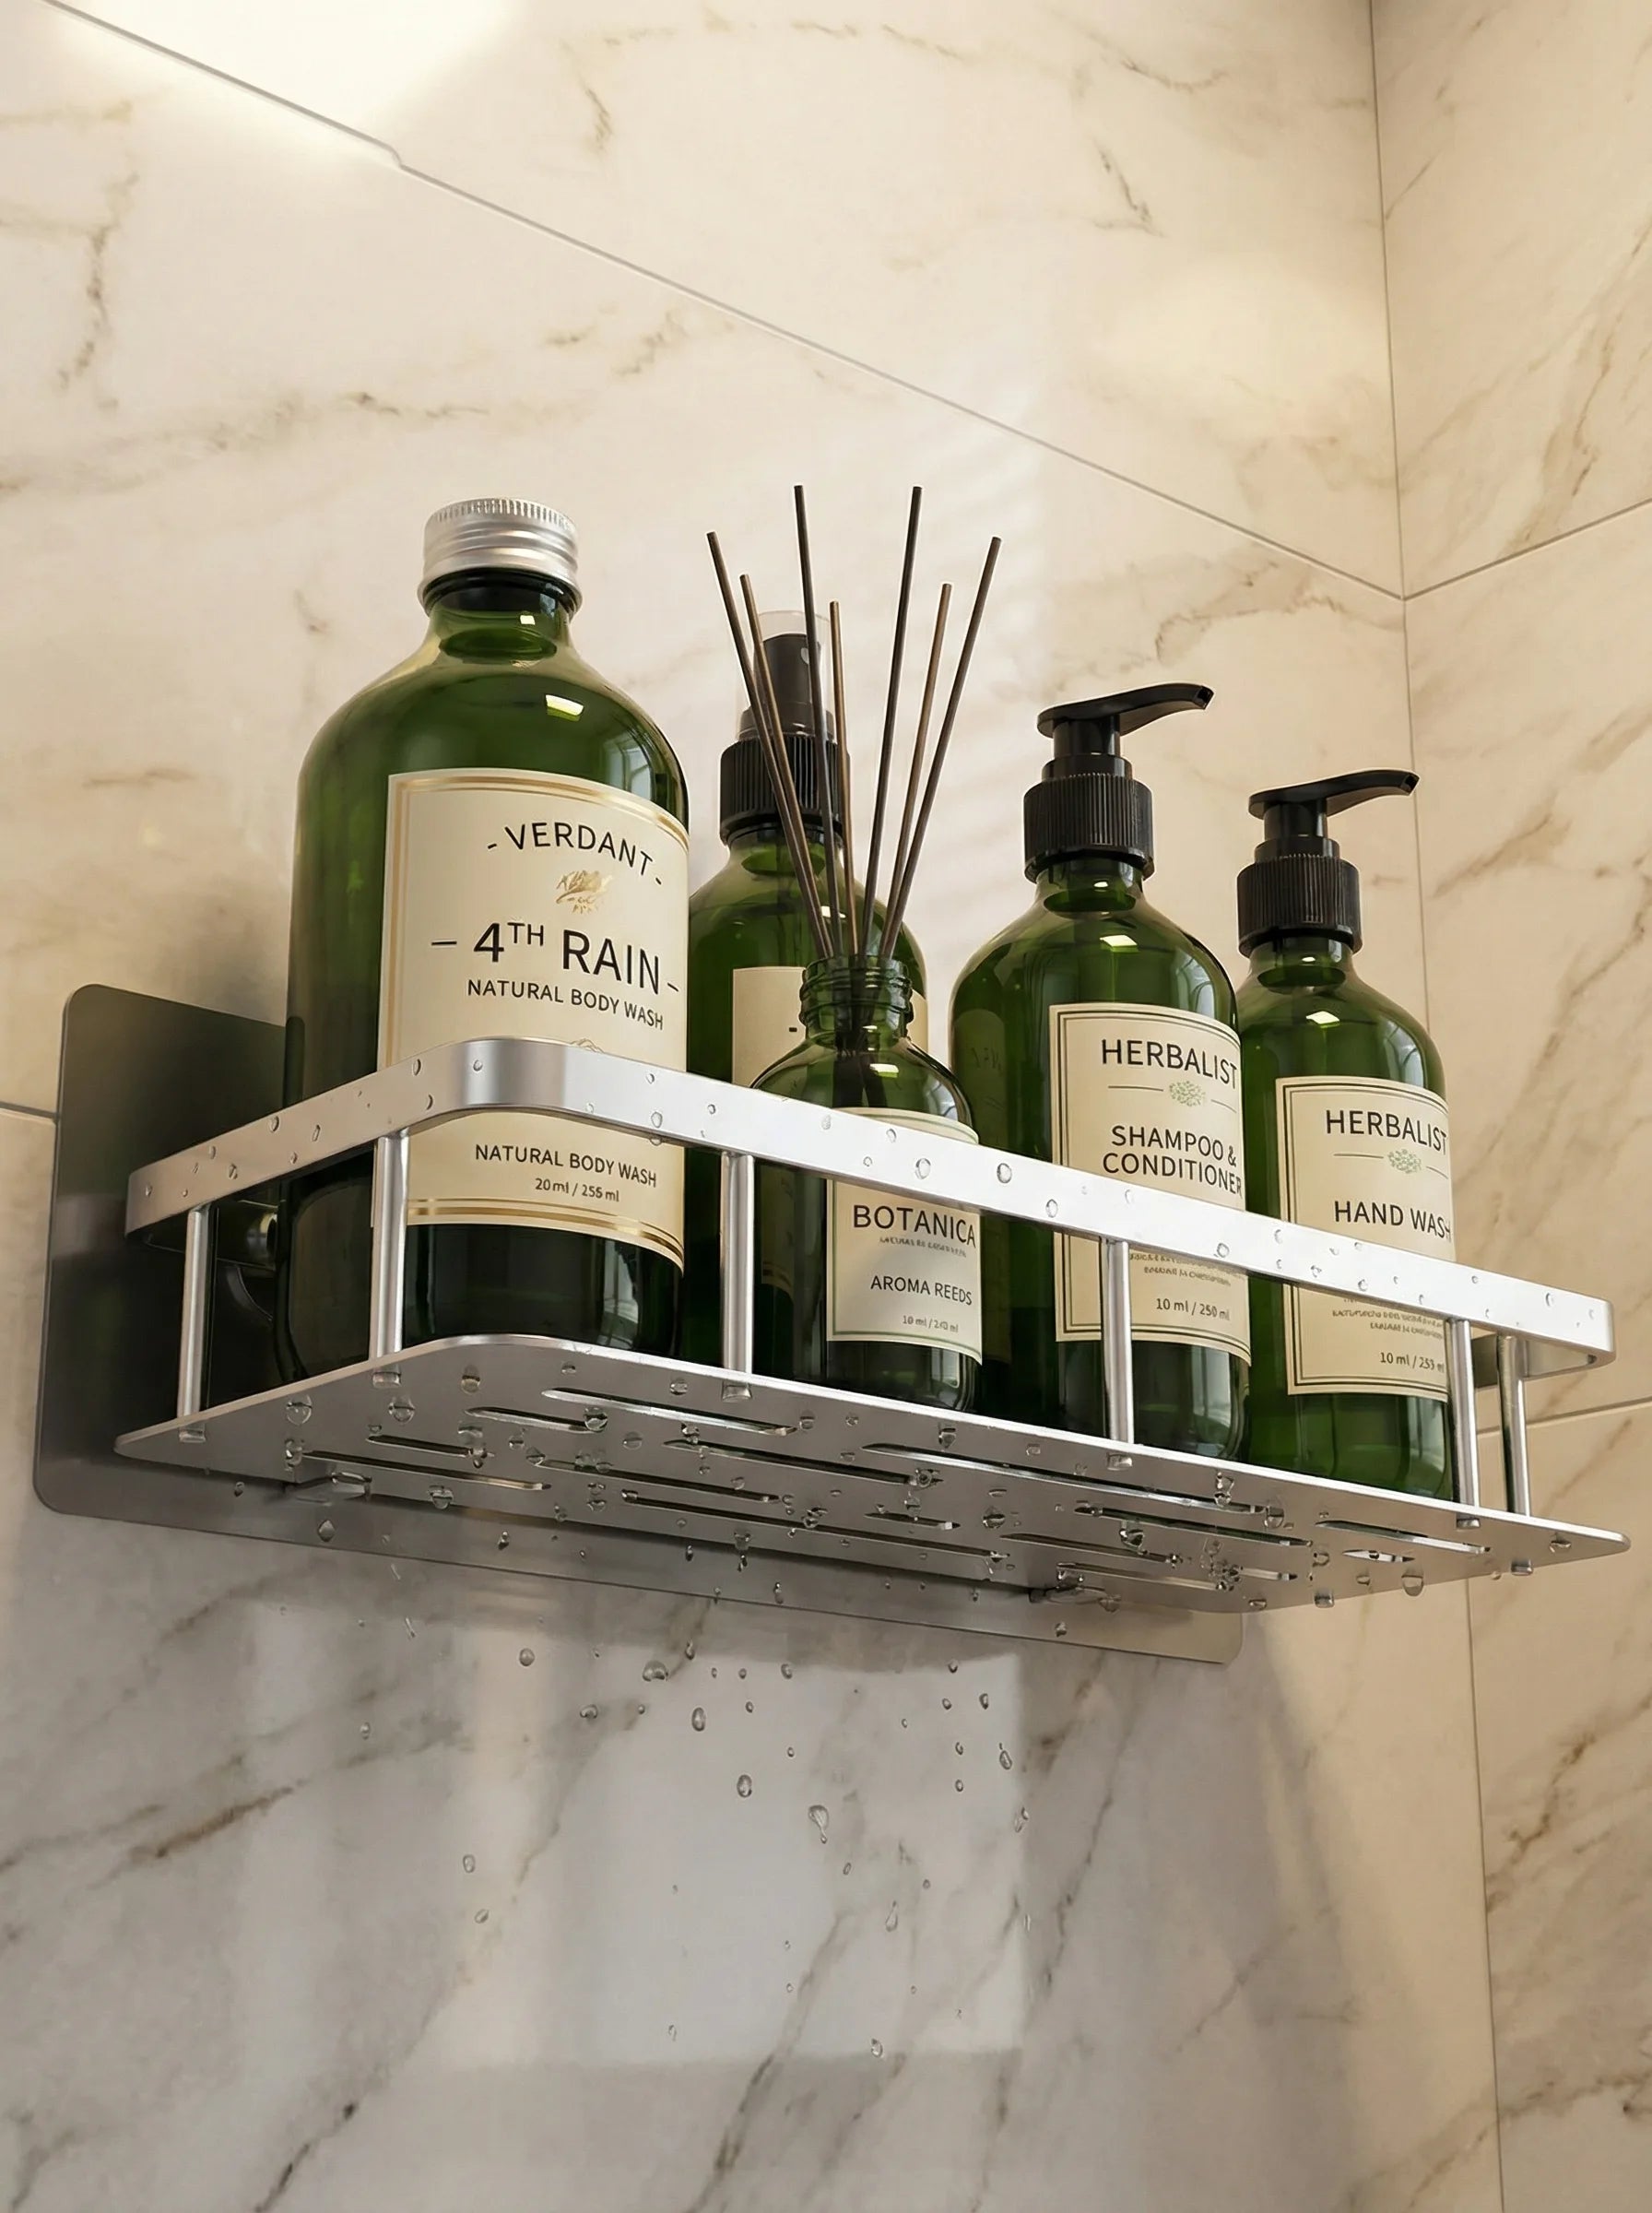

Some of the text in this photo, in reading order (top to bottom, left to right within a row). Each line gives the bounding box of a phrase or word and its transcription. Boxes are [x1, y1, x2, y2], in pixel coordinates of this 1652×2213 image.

[504, 821, 654, 877] VERDANT
[473, 922, 659, 995] 4TH RAIN
[467, 978, 664, 1031] NATURAL BODY WASH
[1102, 1038, 1238, 1090] HERBALIST
[1112, 1125, 1237, 1168] SHAMPOO &
[1326, 1108, 1447, 1155] HERBALIST
[475, 1143, 657, 1189] NATURAL BODY WASH
[1103, 1152, 1243, 1200] CONDITIONER
[535, 1177, 551, 1191] 20
[552, 1180, 570, 1194] ml
[605, 1189, 620, 1202] ml
[853, 1204, 977, 1249] BOTANICA
[1334, 1200, 1452, 1243] HAND WASH
[870, 1275, 973, 1306] AROMA REEDS
[1155, 1297, 1171, 1310] 10
[1174, 1299, 1189, 1313] ml
[1379, 1351, 1394, 1365] 10
[1396, 1354, 1410, 1367] ml
